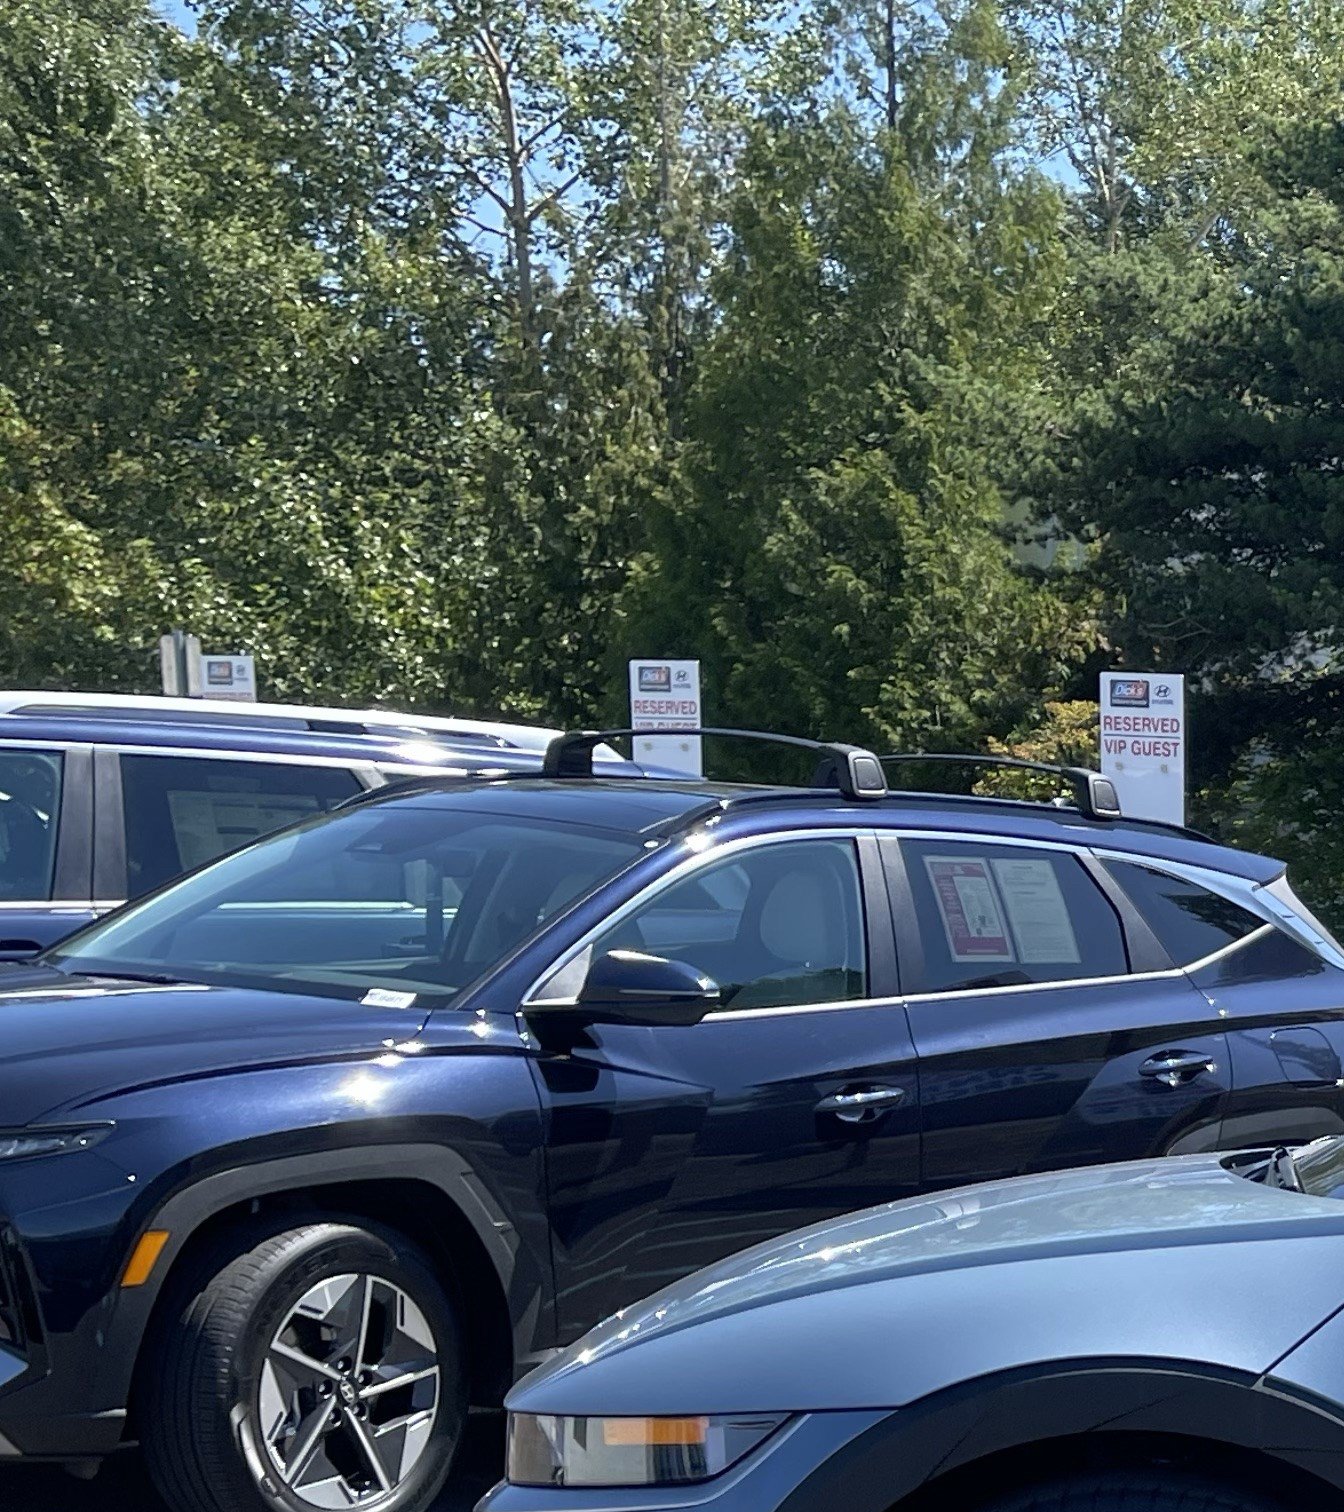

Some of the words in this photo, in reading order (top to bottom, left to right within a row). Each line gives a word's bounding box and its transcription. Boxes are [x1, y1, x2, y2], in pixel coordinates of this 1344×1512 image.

[633, 700, 698, 715] RESERVED
[1103, 715, 1180, 733] RESERVED
[1104, 739, 1127, 754] VIP
[1131, 740, 1180, 757] GUEST
